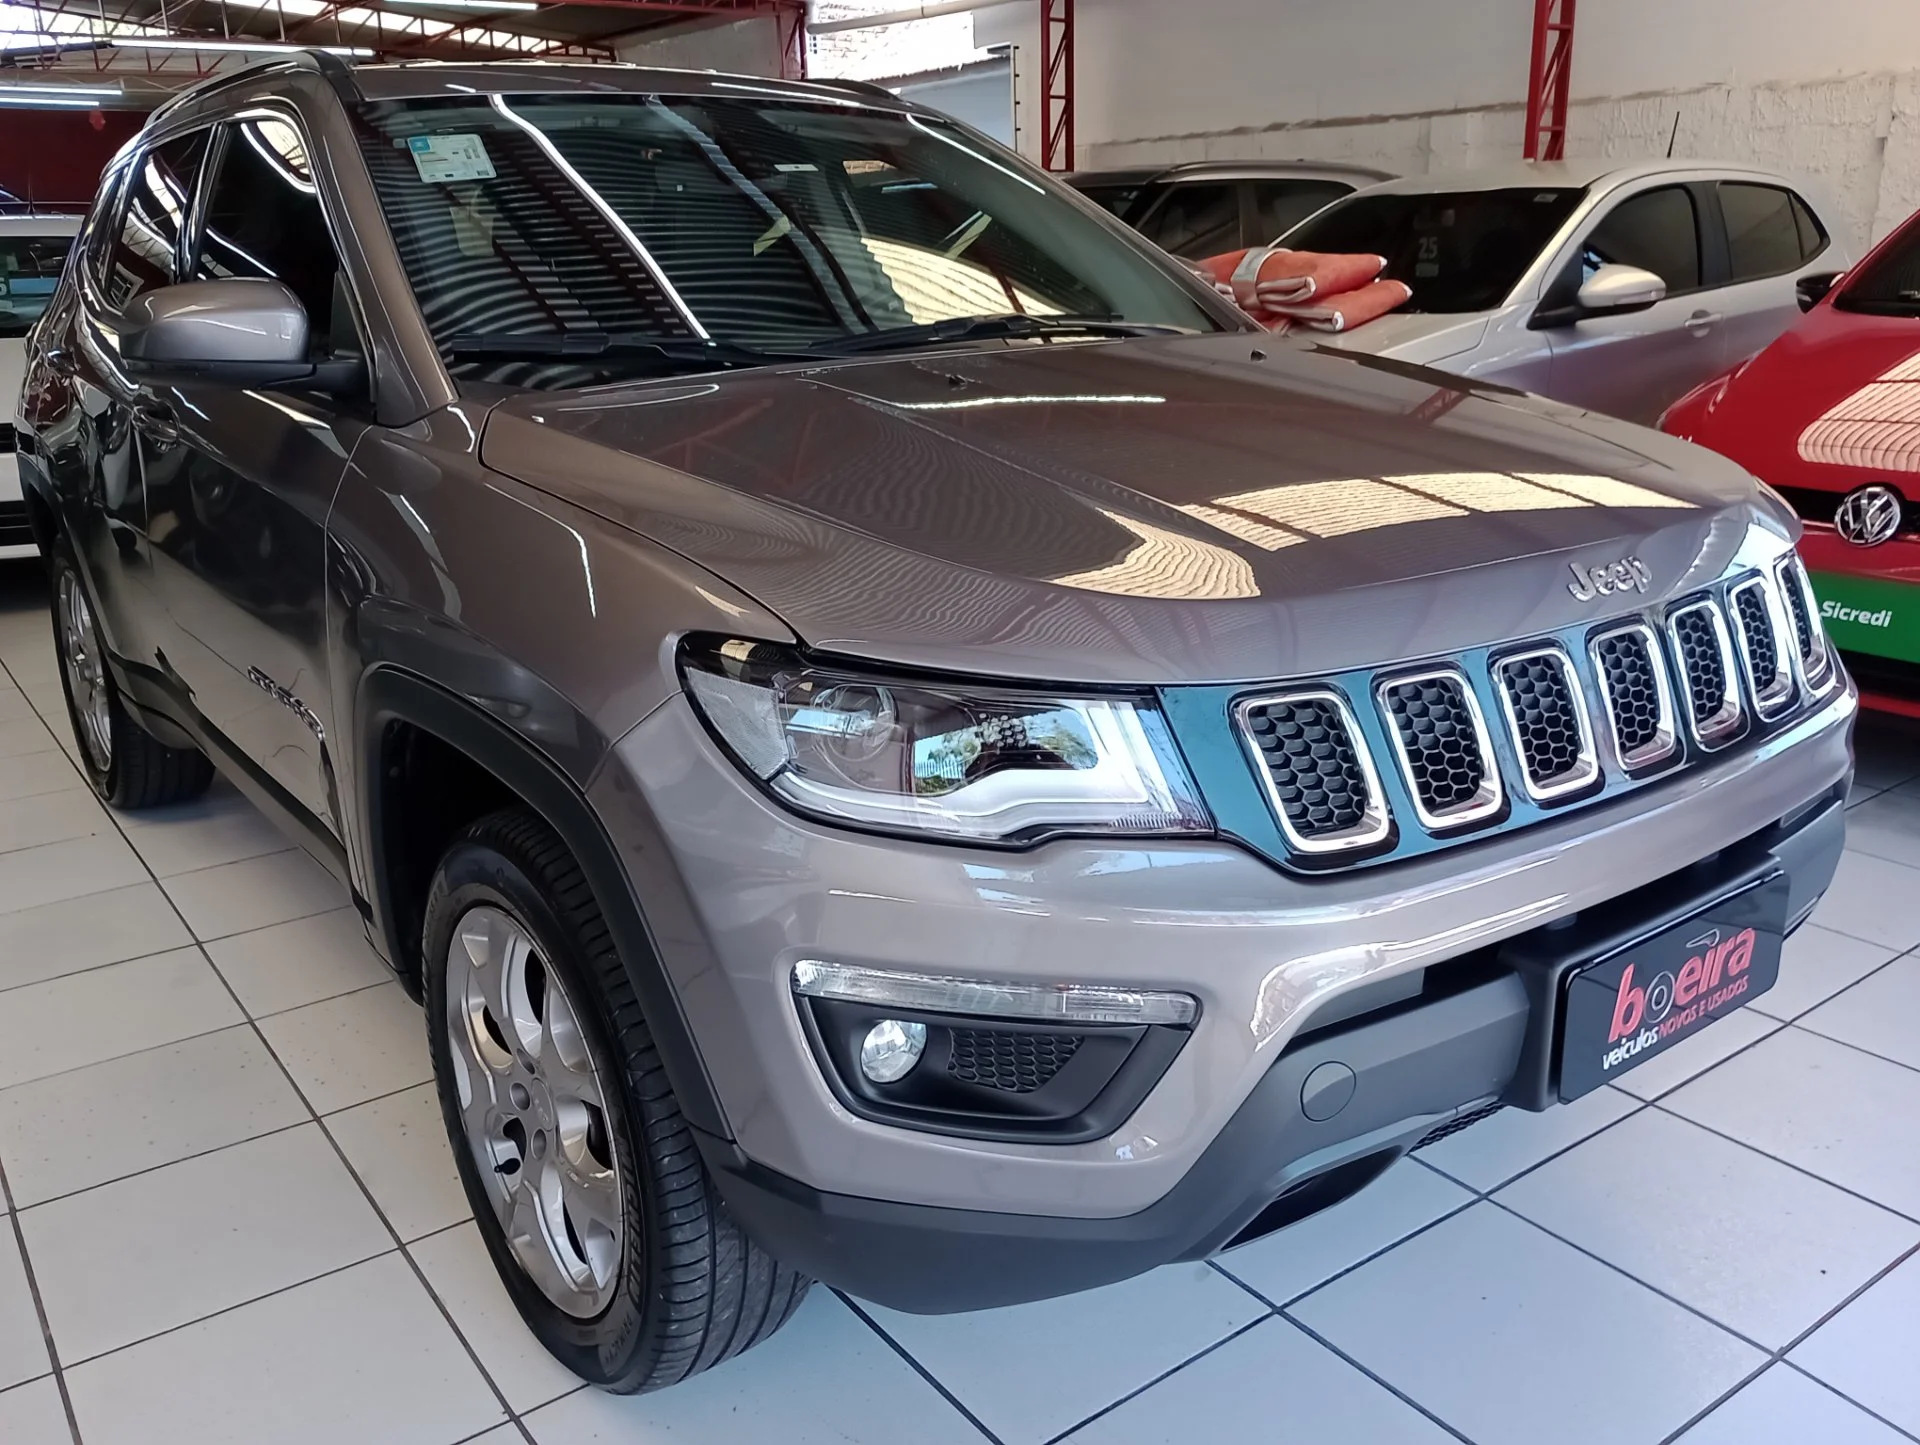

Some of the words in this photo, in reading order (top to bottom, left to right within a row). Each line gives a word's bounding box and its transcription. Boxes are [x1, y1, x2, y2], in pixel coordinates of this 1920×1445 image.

[1417, 236, 1438, 259] 25
[1567, 555, 1652, 602] Jeep
[1820, 600, 1893, 628] Sicredi
[1658, 1004, 1699, 1039] NOVOS
[1698, 999, 1707, 1017] E
[1707, 974, 1749, 1011] USADOS
